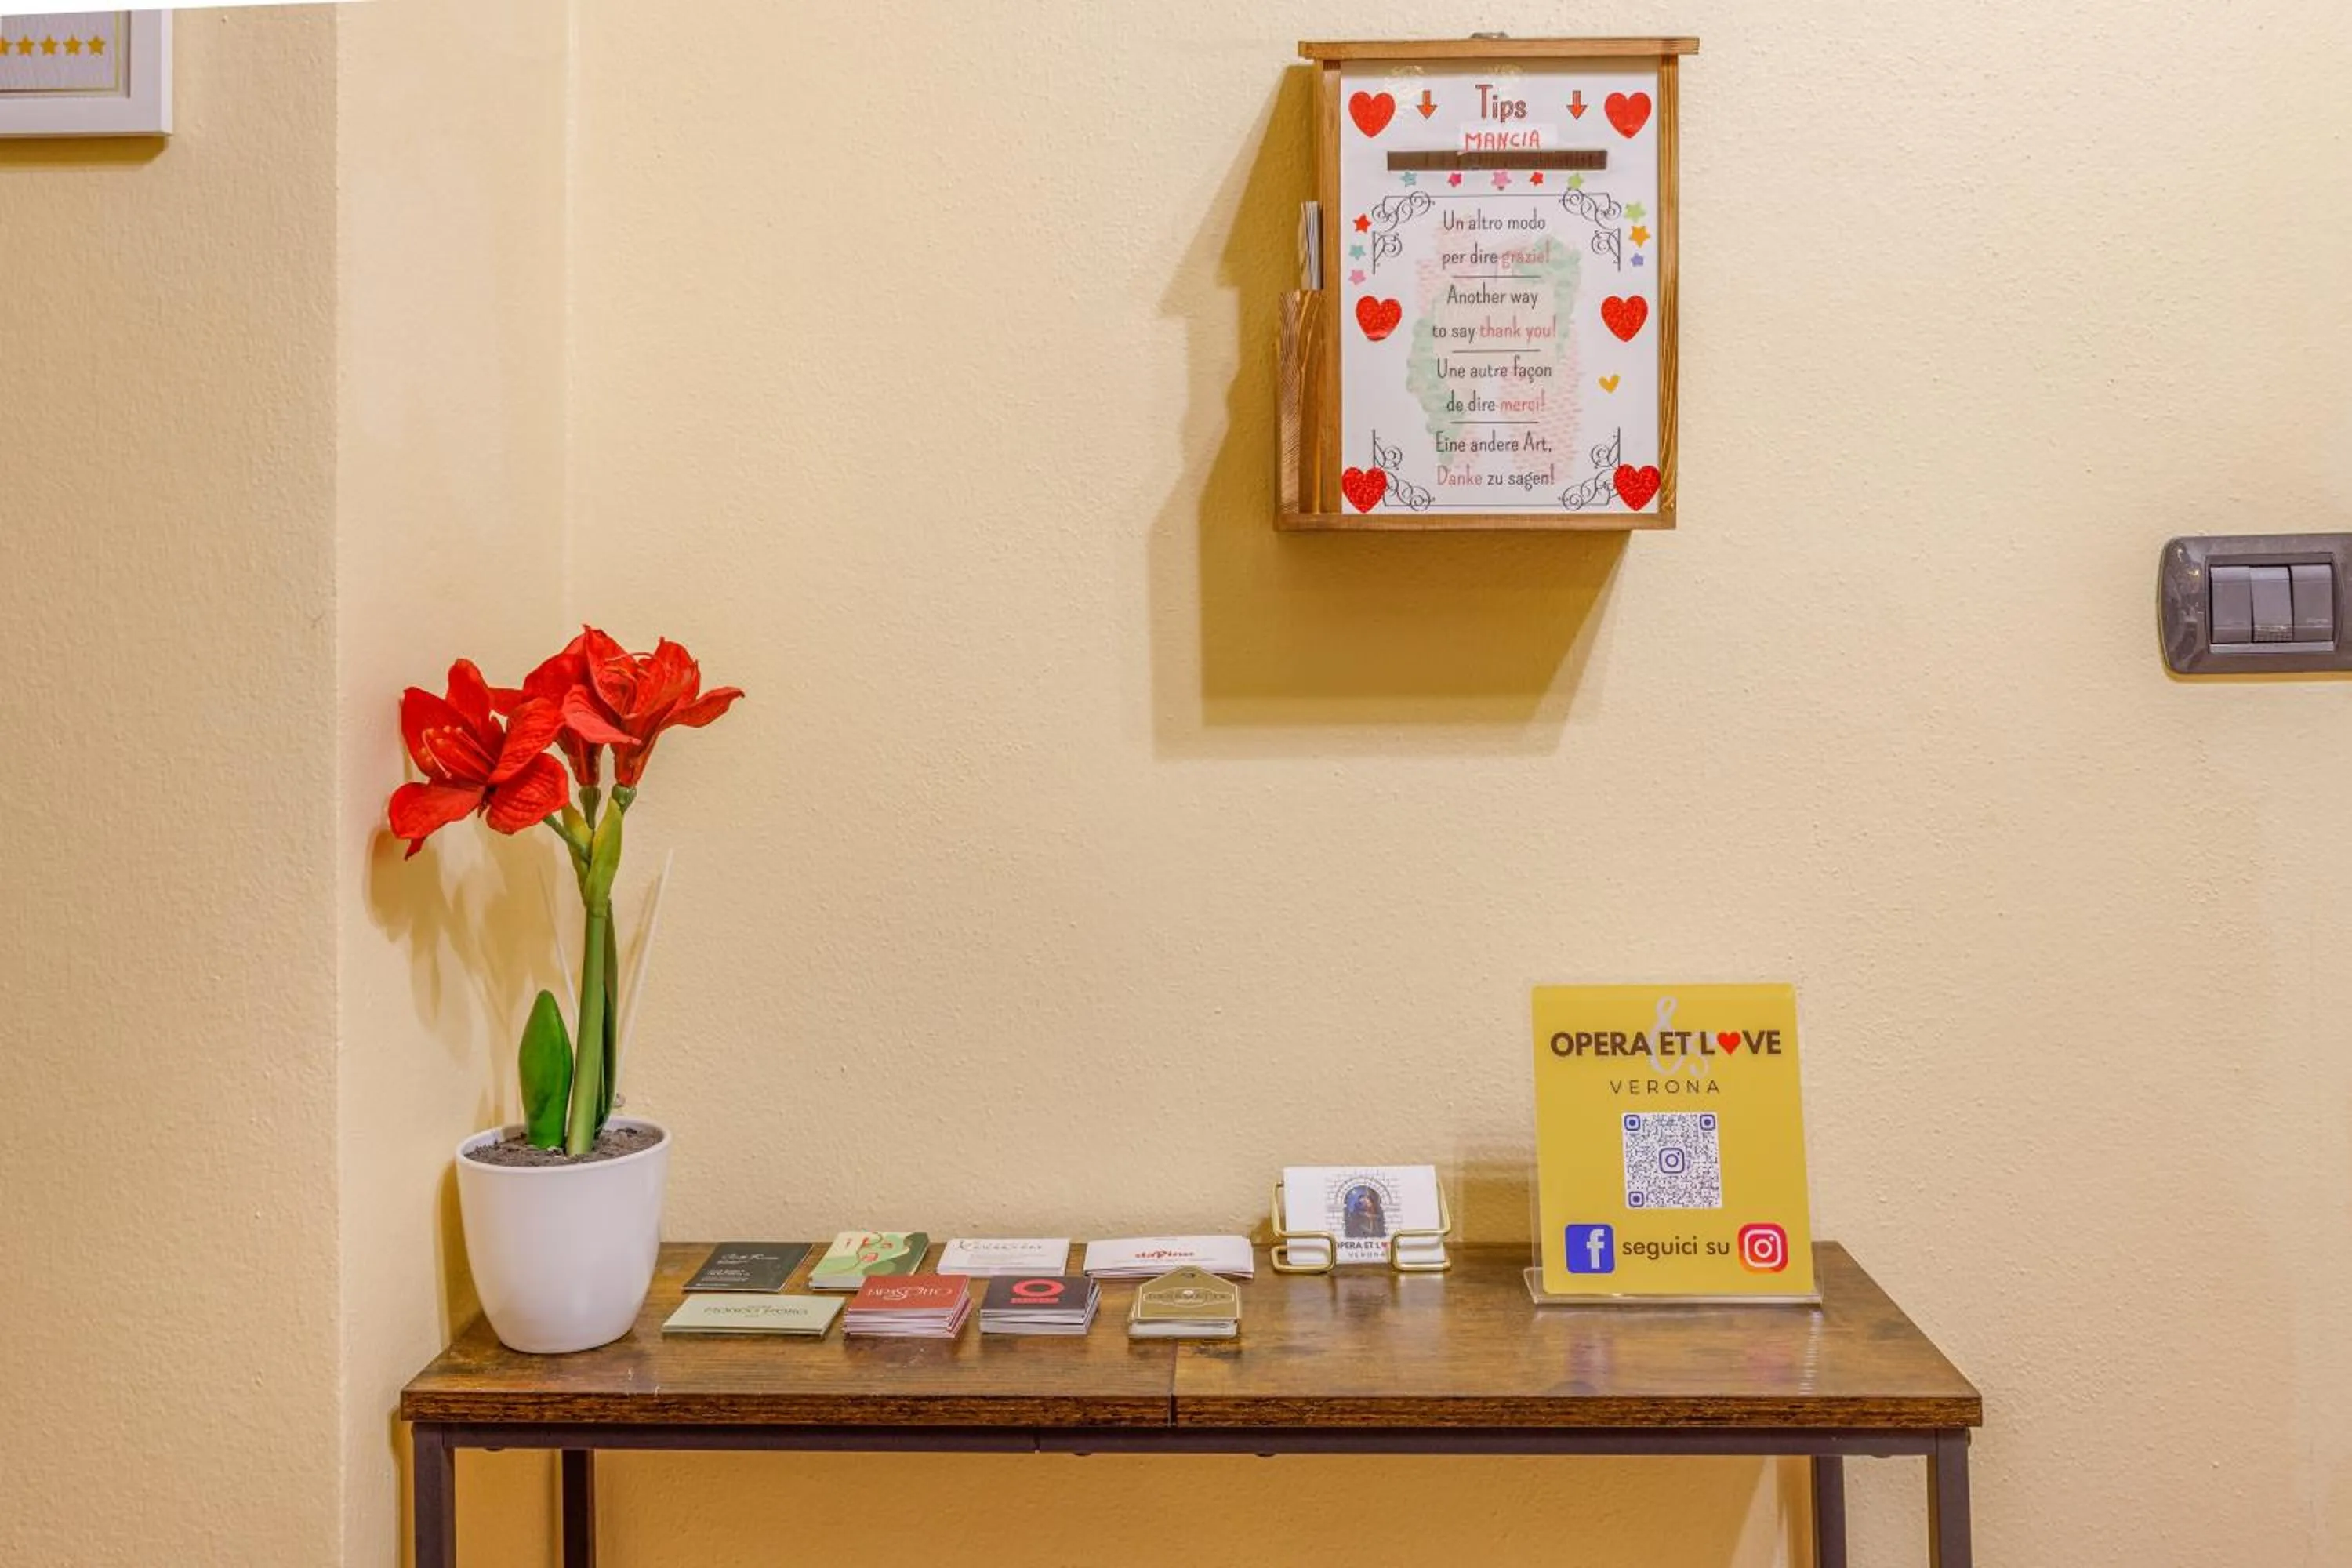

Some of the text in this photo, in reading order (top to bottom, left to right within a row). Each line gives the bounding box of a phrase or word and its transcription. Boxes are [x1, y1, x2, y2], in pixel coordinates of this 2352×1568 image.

[1475, 84, 1527, 123] Tips
[1465, 129, 1541, 151] MANCIA
[1443, 208, 1546, 230] Un altro modo
[1442, 239, 1550, 270] per dire grazie!
[1446, 282, 1537, 309] Another way
[1432, 315, 1556, 343] to say thank you!
[1436, 356, 1552, 383] Une autre façon
[1446, 390, 1546, 412] de dire merci!
[1436, 430, 1552, 453] Eine andere Art,
[1436, 463, 1555, 491] Danke zu sagen!
[1550, 1032, 1653, 1057] OPERA
[1660, 1031, 1691, 1055] ET
[1610, 1079, 1720, 1095] VERONA
[1622, 1236, 1698, 1260] seguici
[1706, 1240, 1730, 1255] su
